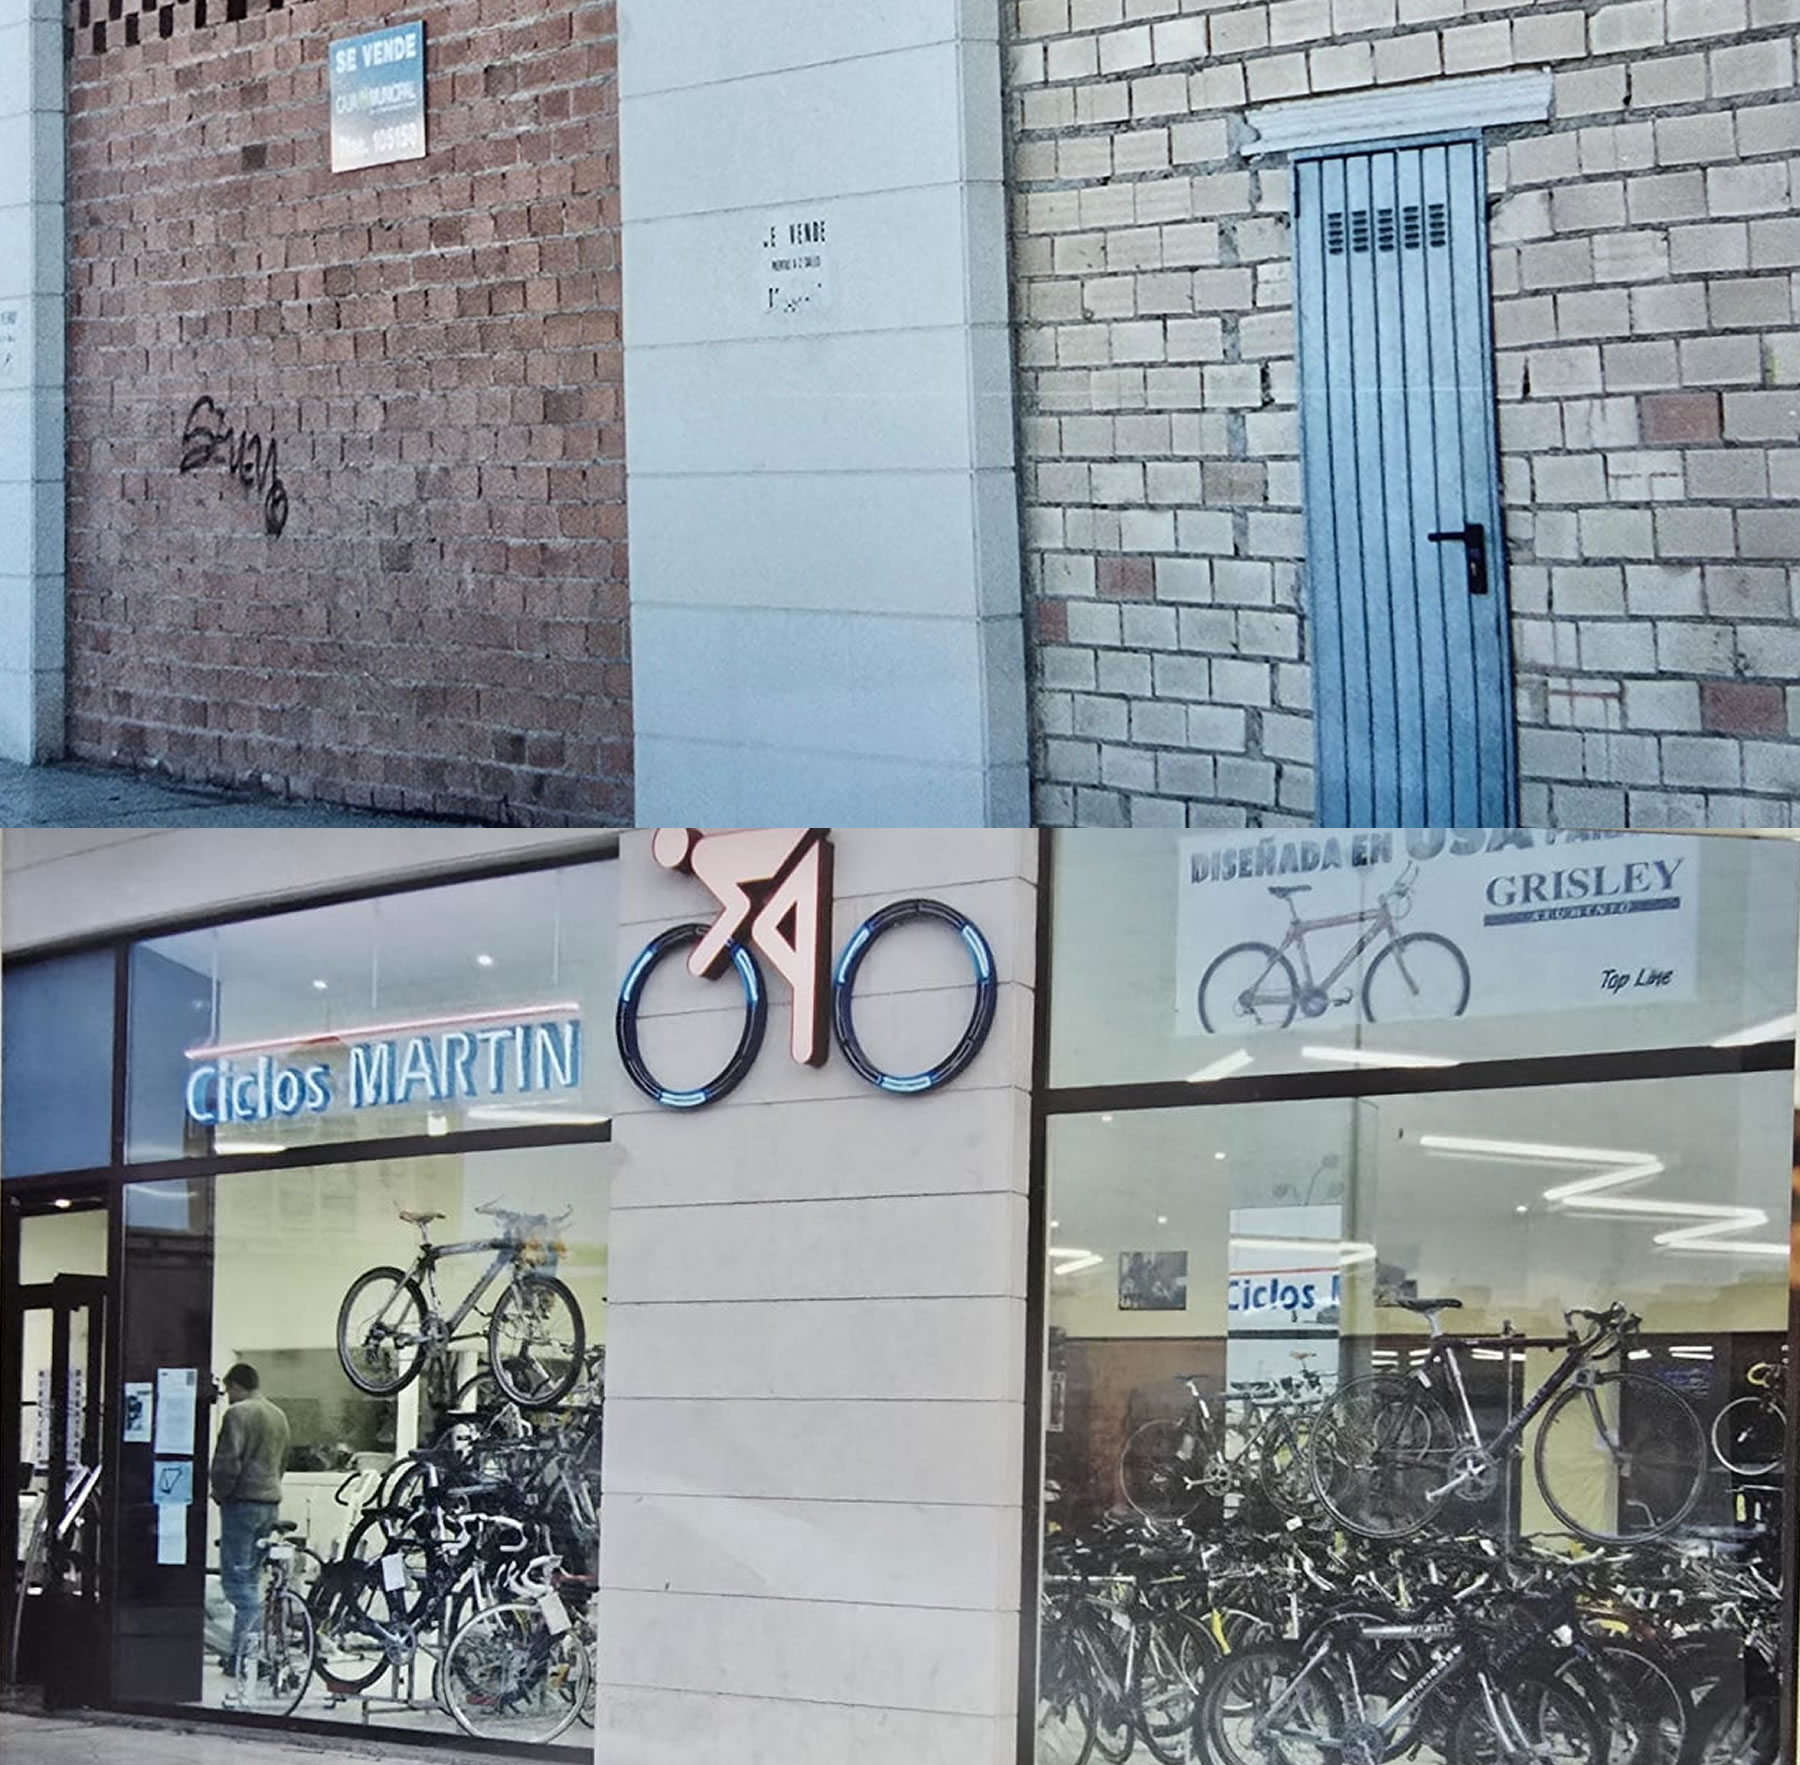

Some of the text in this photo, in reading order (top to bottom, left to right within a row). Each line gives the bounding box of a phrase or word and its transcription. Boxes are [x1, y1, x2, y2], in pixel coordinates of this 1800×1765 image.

[335, 33, 417, 73] SE VENDE
[1191, 836, 1342, 884] DISEÑADA
[1351, 832, 1394, 868] EN
[1485, 857, 1684, 908] GRISLEY
[1600, 968, 1631, 995] Top
[185, 1019, 581, 1126] Ciclos MARTIN
